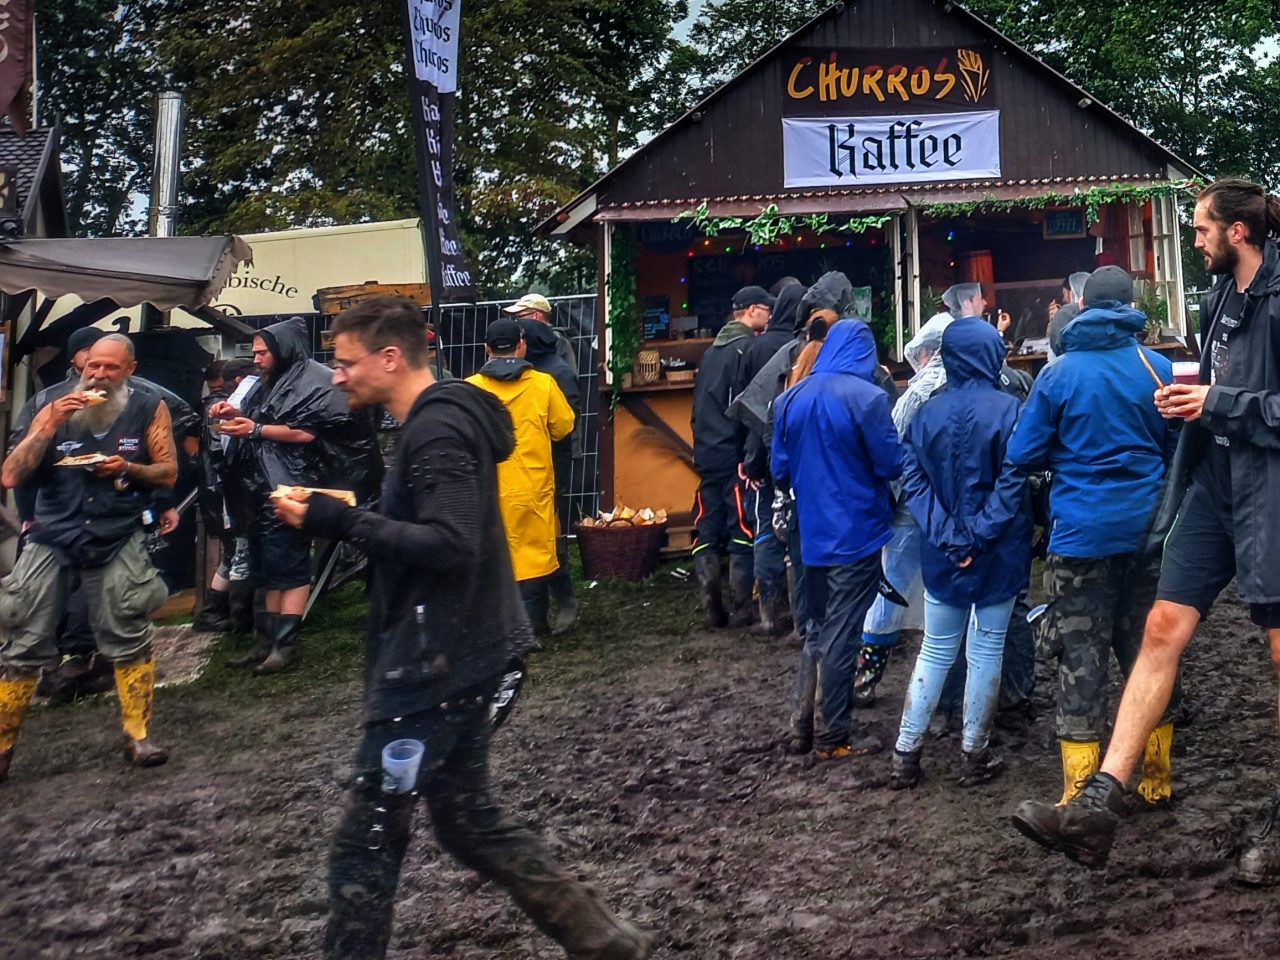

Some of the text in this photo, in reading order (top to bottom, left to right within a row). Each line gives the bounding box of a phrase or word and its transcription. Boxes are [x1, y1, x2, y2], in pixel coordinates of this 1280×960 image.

[787, 51, 957, 102] CHURROS
[826, 119, 964, 180] Kaffee
[225, 276, 299, 299] bische
